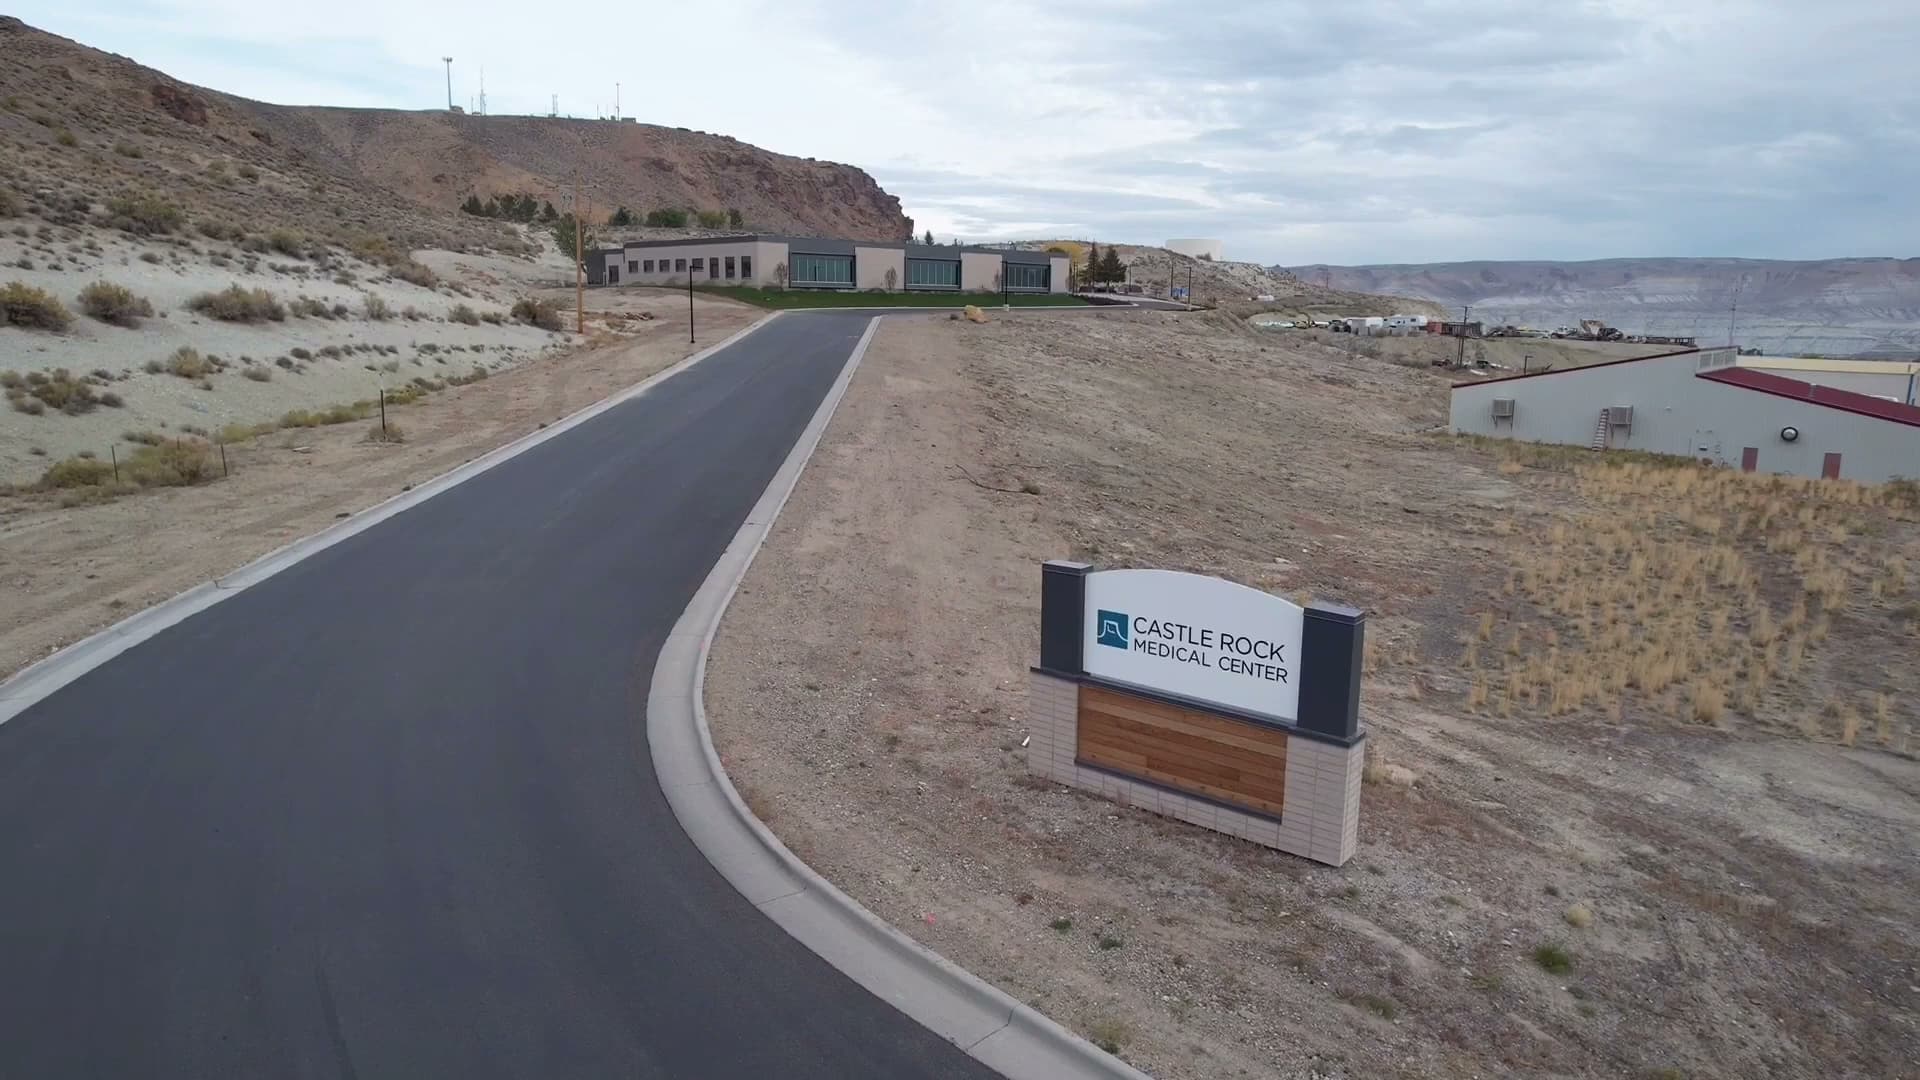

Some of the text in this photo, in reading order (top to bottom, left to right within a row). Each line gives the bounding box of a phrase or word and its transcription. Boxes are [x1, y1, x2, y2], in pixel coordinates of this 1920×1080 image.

[1133, 616, 1285, 662] CASTLE ROCK
[1134, 638, 1288, 683] MEDICAL CENTER
